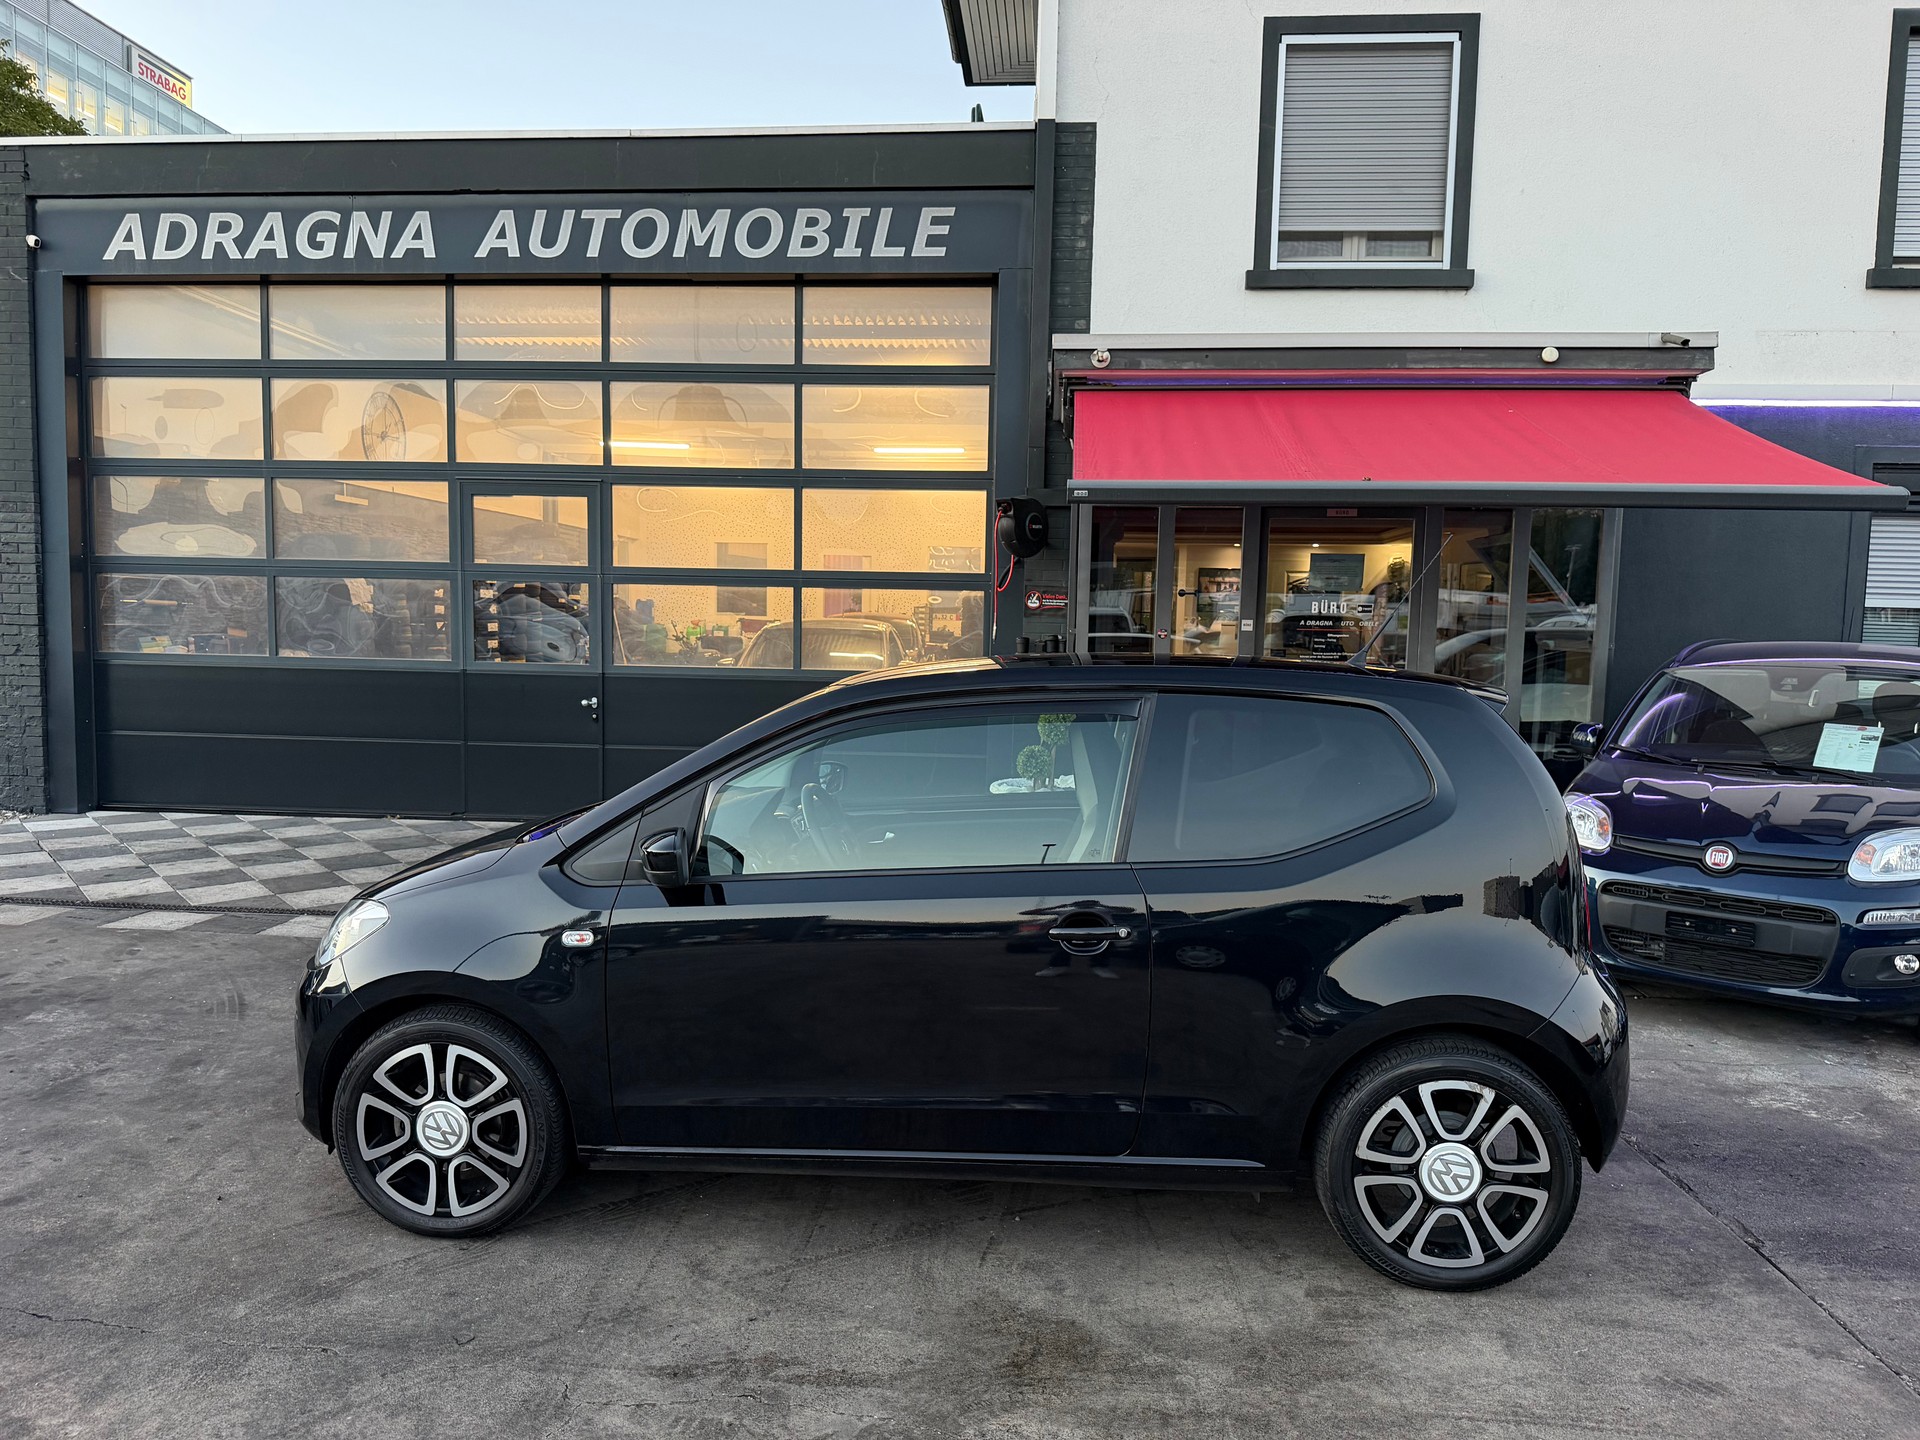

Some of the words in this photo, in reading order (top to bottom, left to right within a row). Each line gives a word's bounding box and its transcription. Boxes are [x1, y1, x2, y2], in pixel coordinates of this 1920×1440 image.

[138, 61, 187, 101] STRABAG
[102, 210, 437, 260] ADRAGNA
[474, 207, 957, 259] AUTOMOBILE
[1311, 600, 1347, 614] BÜRO
[1711, 851, 1729, 865] FIAT
